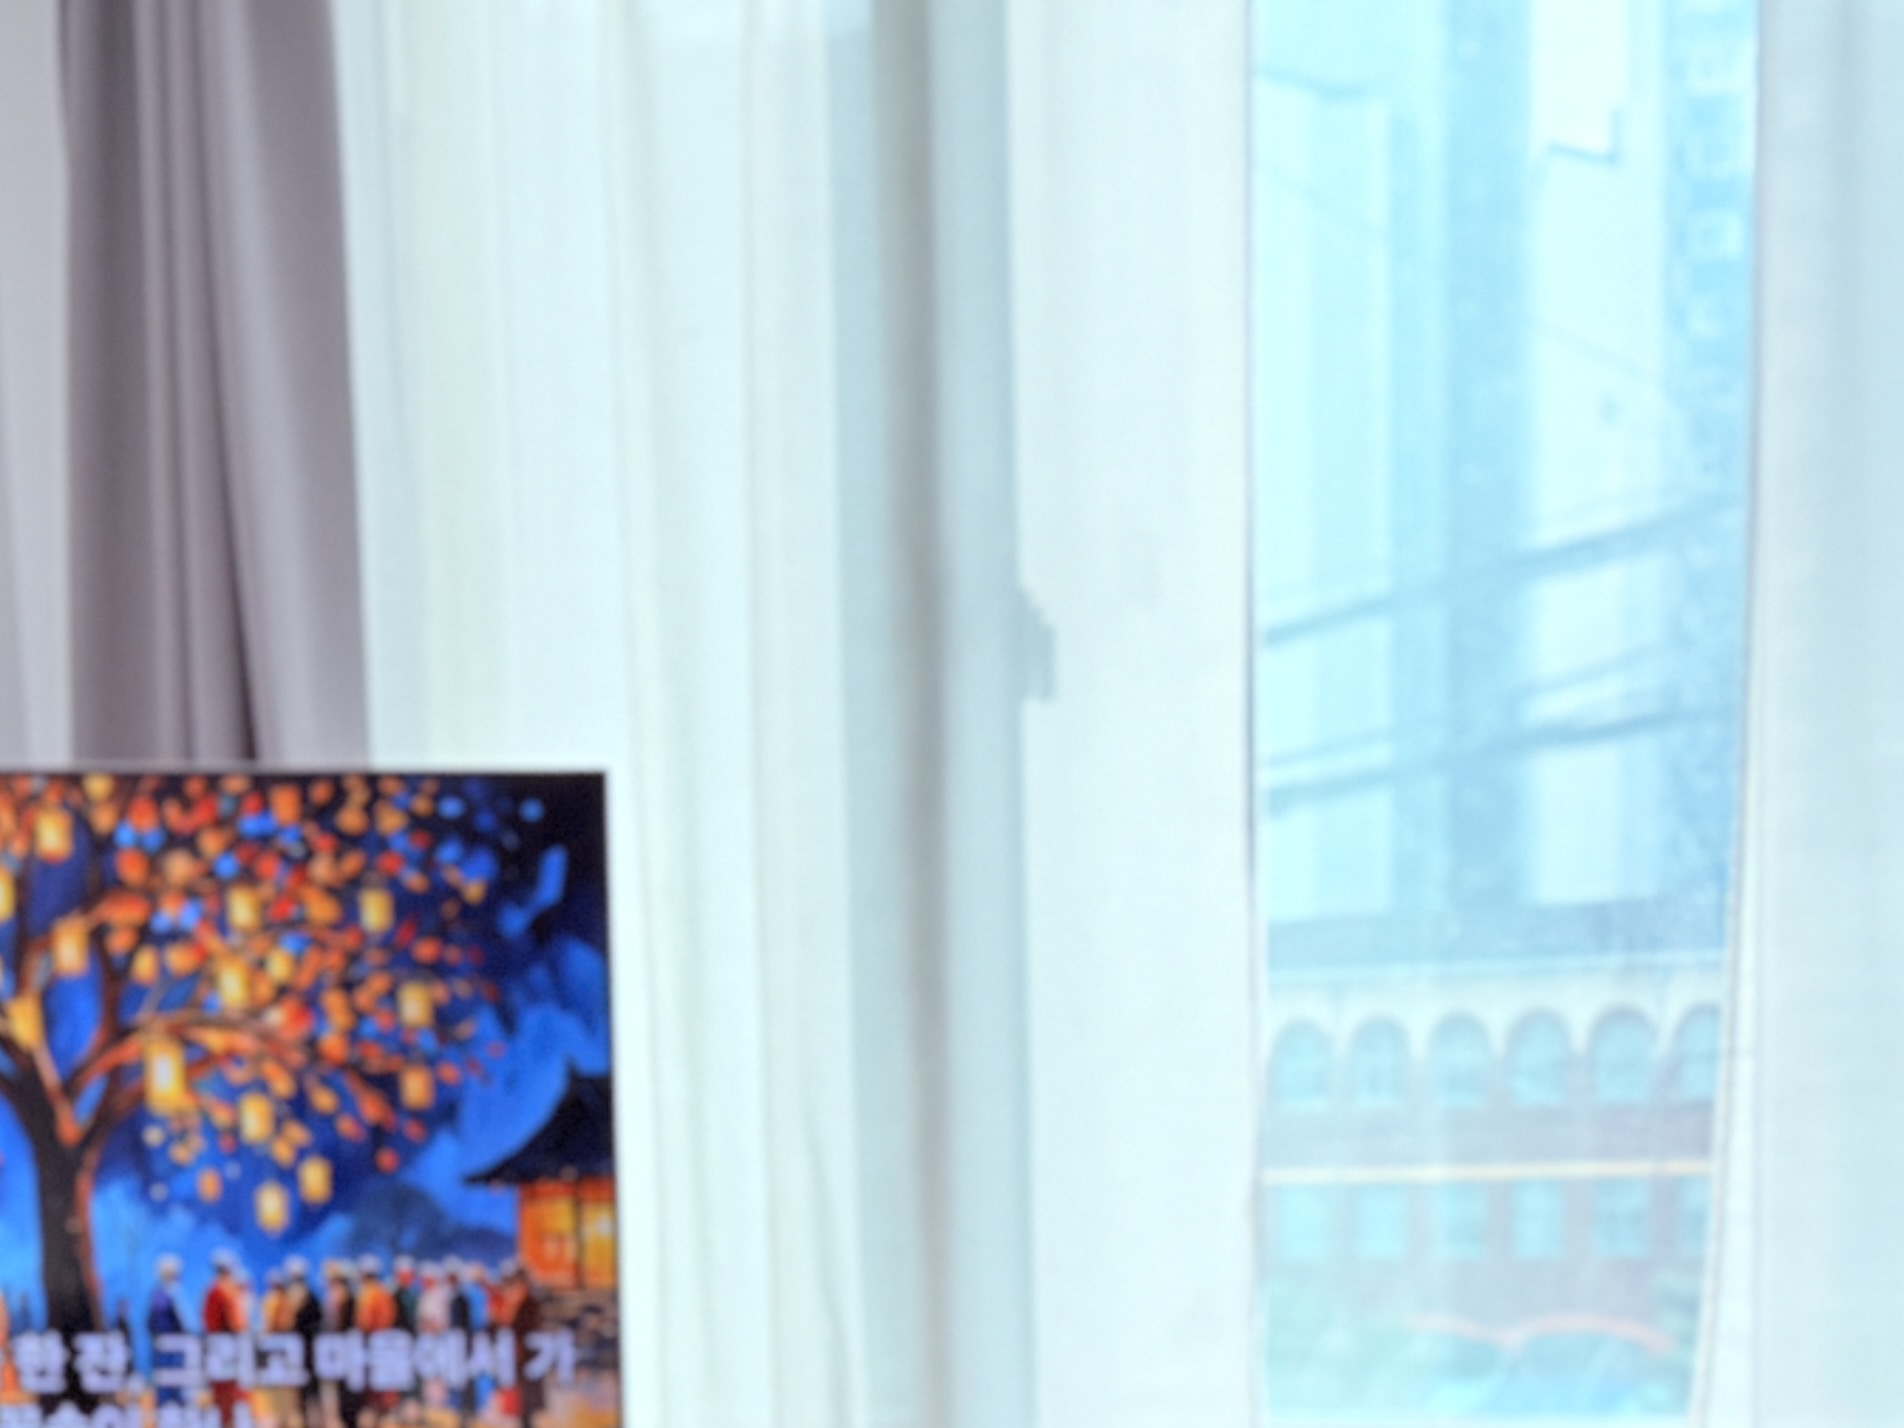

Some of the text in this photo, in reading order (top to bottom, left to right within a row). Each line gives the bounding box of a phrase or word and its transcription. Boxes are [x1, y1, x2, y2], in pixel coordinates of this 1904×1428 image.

[10, 1329, 70, 1394] 한
[154, 1329, 310, 1389] 그리고
[313, 1327, 517, 1392] 마을에서
[521, 1327, 577, 1384] 가
